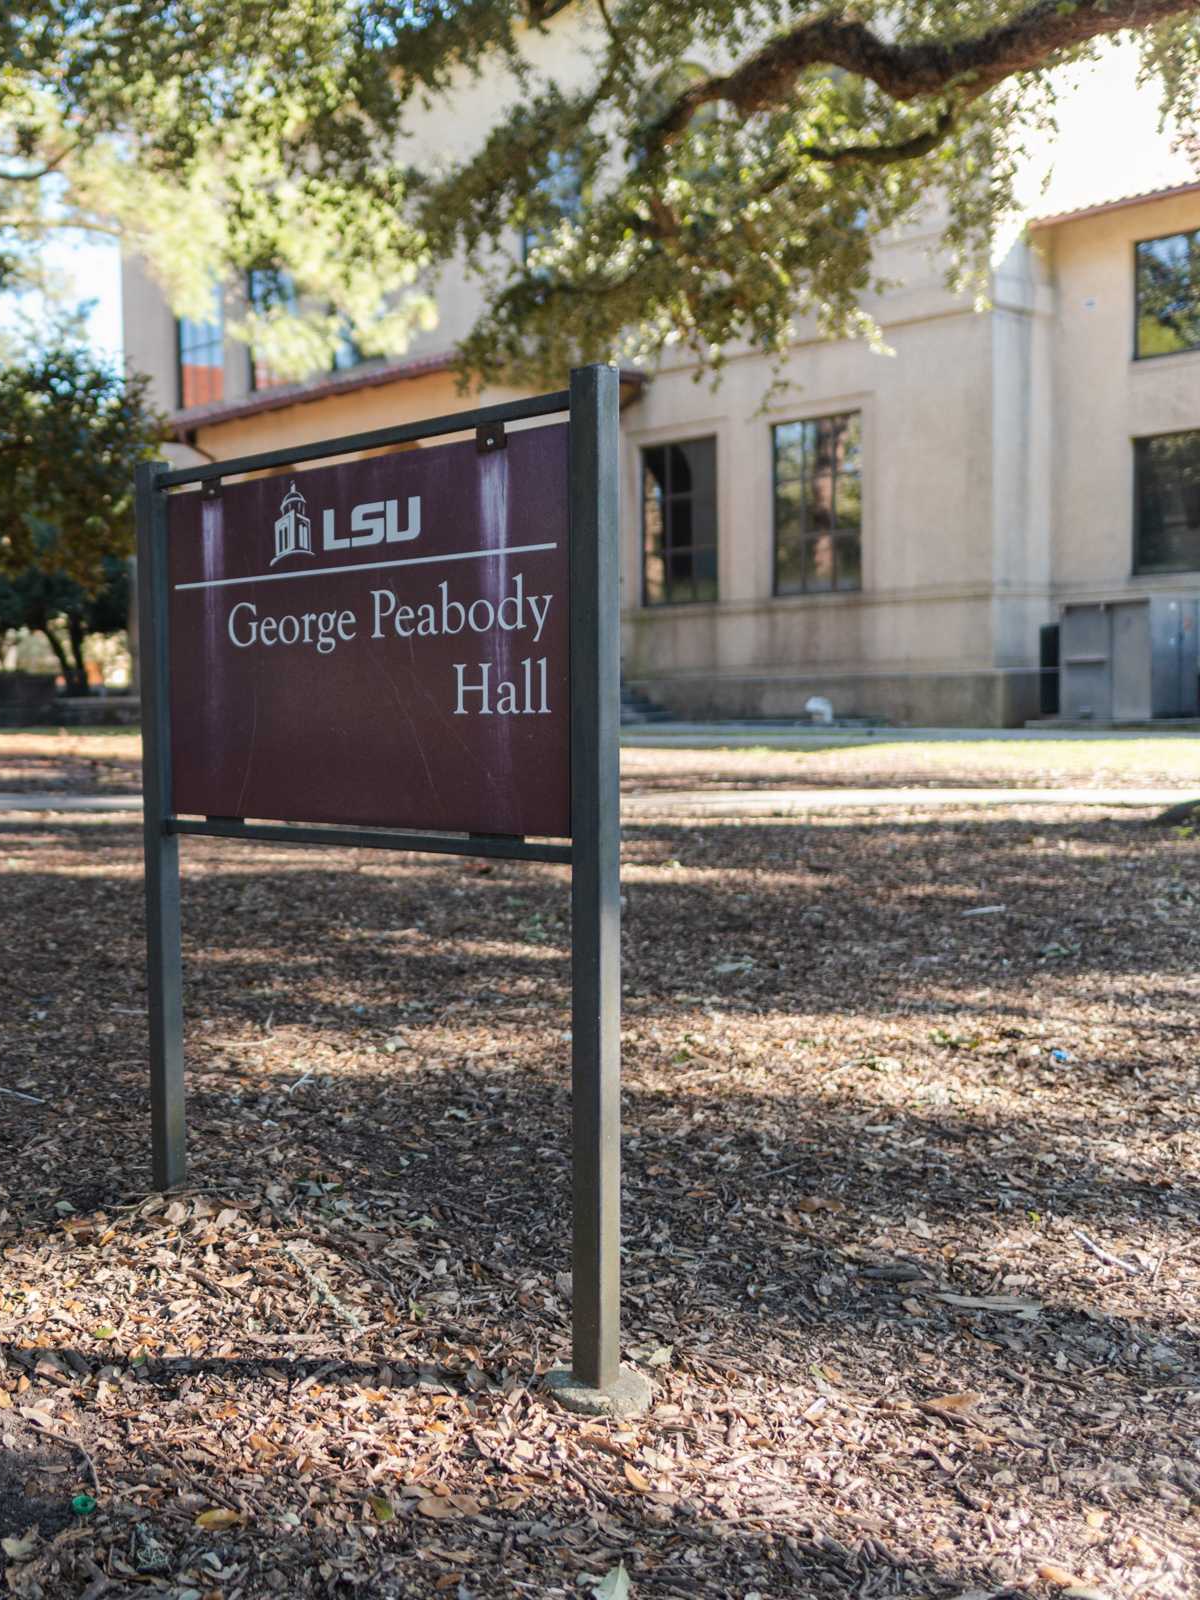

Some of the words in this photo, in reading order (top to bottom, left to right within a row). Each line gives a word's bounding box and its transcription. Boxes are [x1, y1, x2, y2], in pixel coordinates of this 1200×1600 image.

[323, 495, 422, 552] LSU
[227, 602, 357, 654] George
[370, 573, 554, 642] Peabody
[452, 657, 552, 716] Hall
